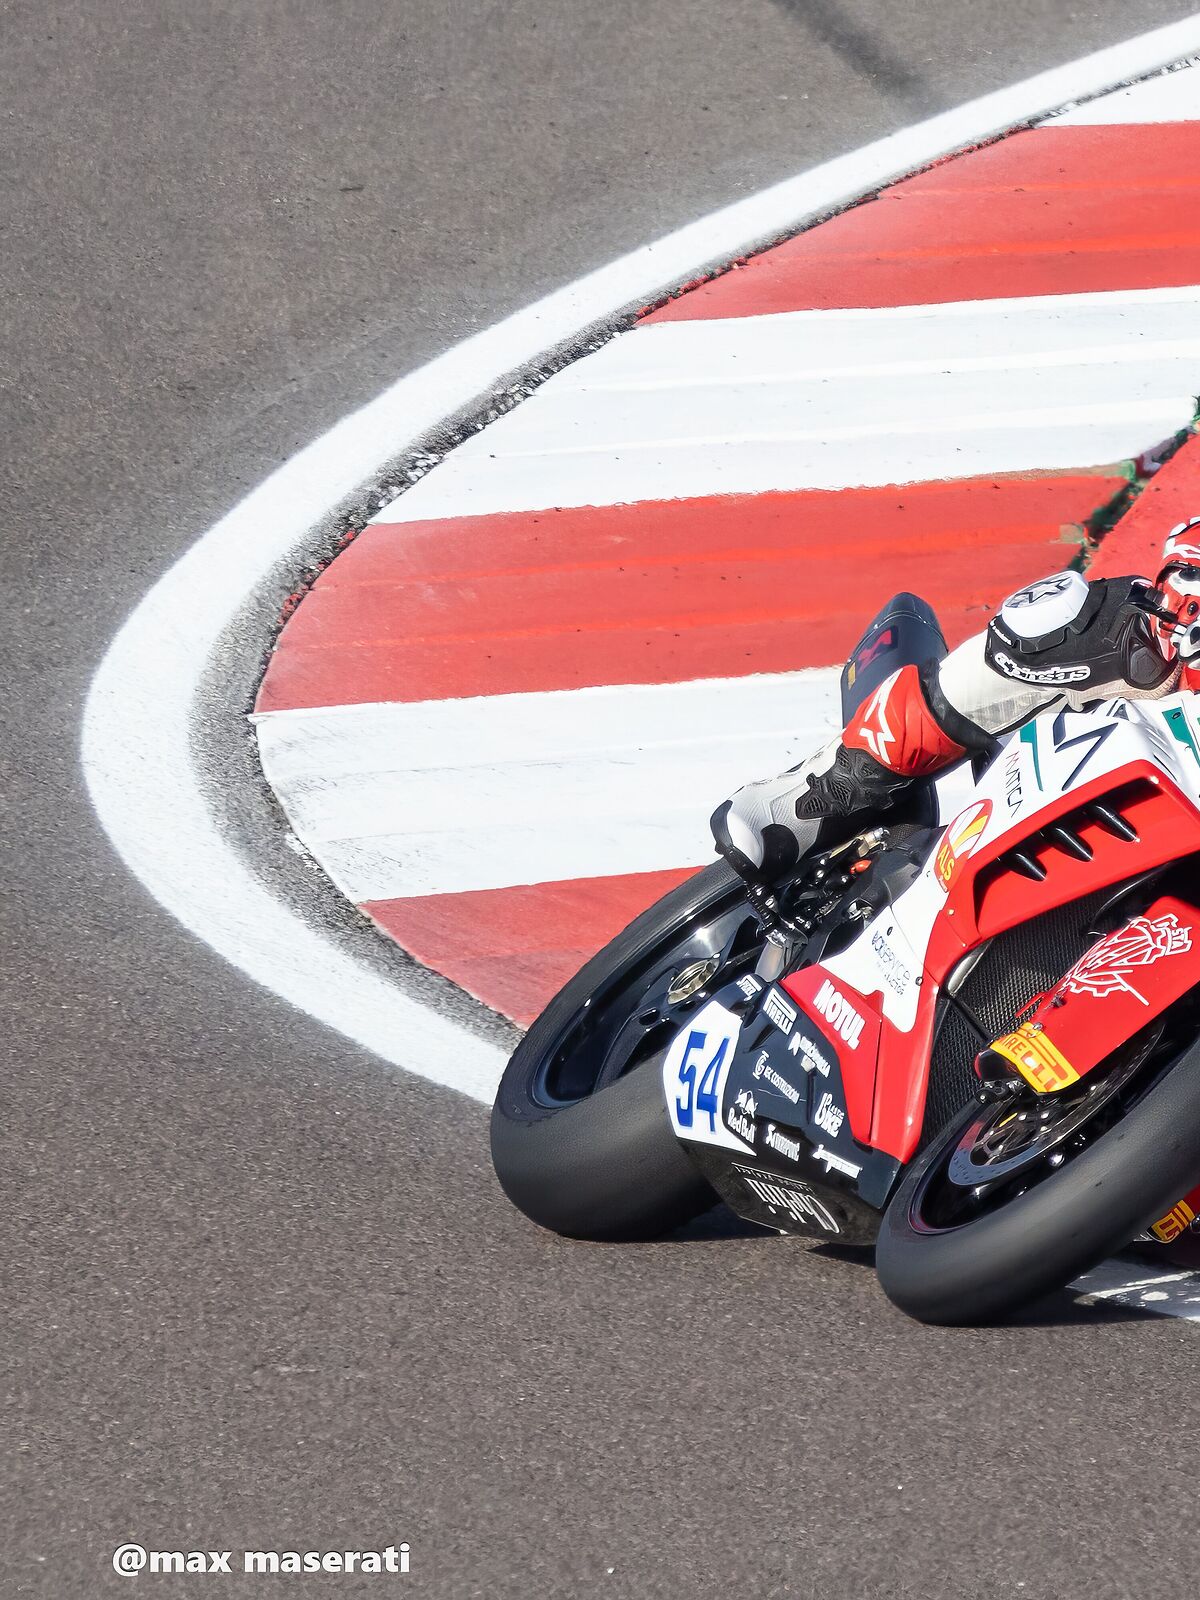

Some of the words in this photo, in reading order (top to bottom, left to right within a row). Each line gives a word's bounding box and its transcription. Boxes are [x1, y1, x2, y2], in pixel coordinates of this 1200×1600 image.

[937, 845, 955, 882] ALS
[763, 988, 798, 1036] PIRELLI
[812, 979, 866, 1050] MOTUL
[675, 1029, 731, 1135] 54
[728, 1107, 744, 1134] Red
[741, 1117, 757, 1144] Bull
